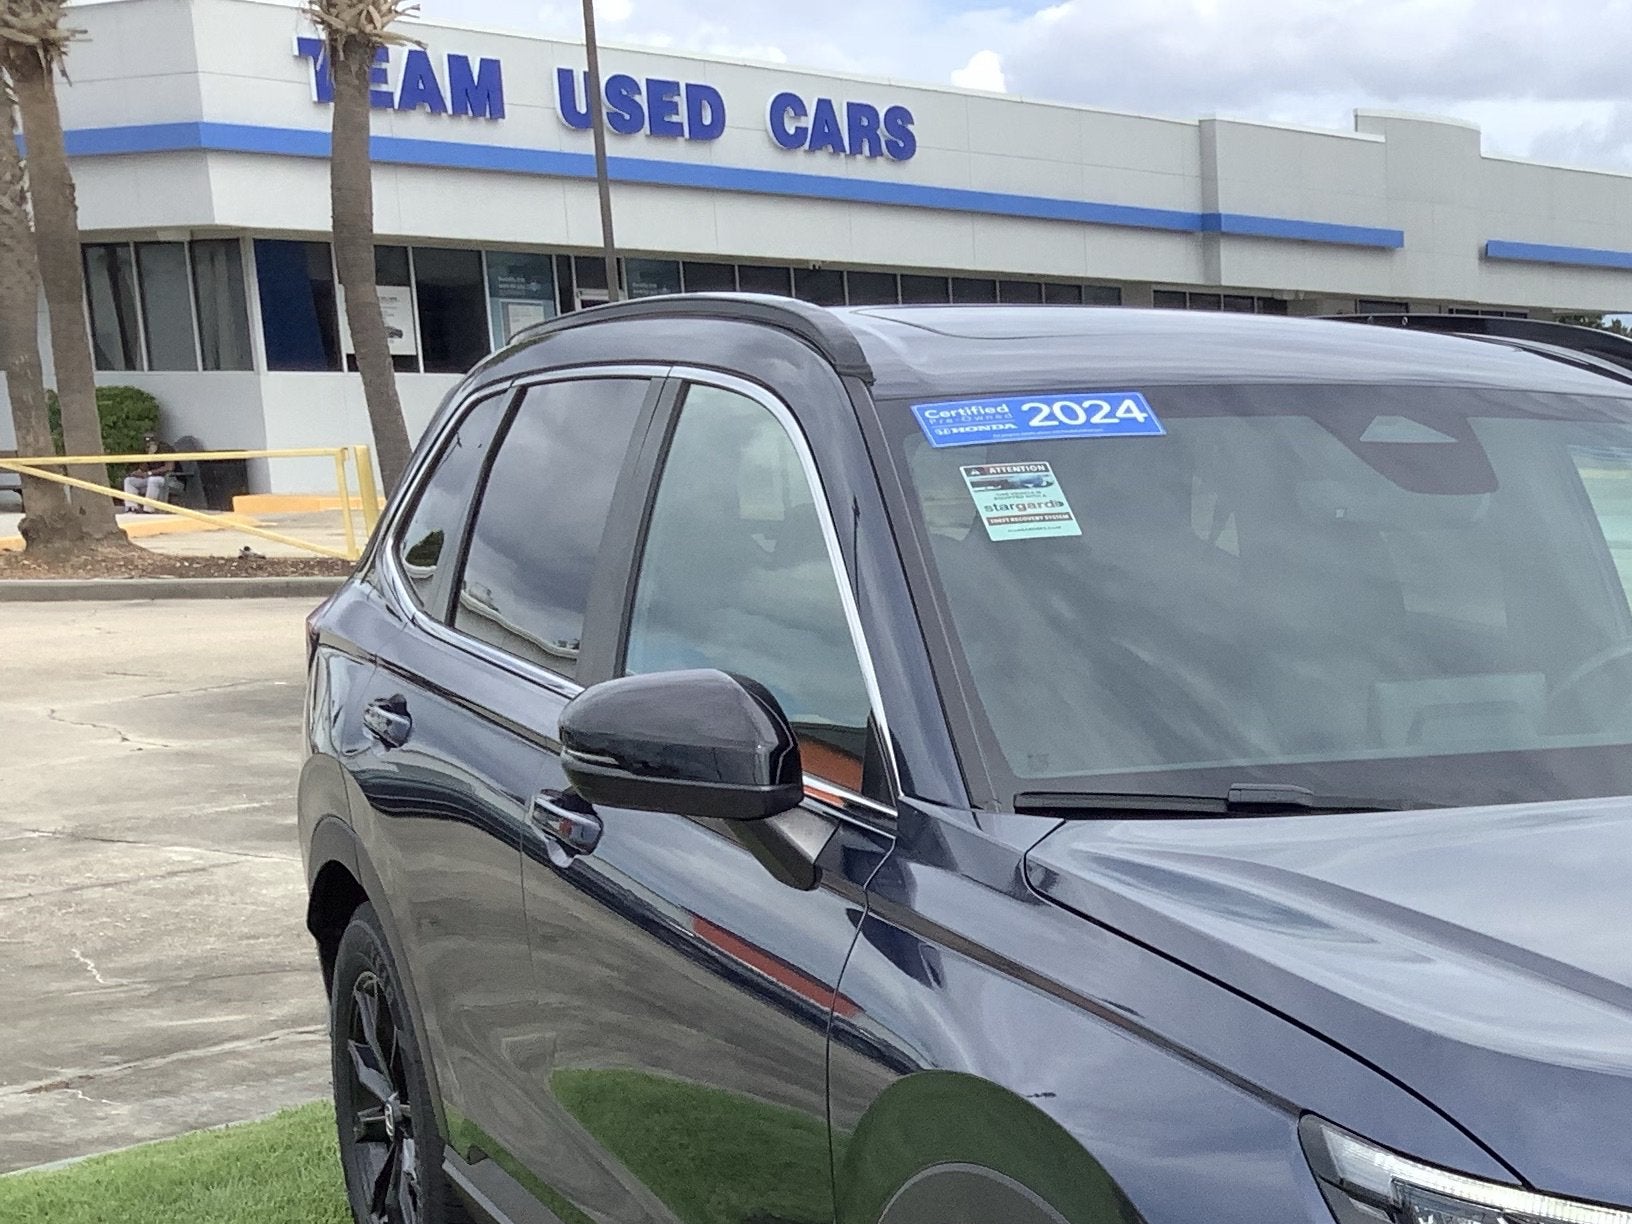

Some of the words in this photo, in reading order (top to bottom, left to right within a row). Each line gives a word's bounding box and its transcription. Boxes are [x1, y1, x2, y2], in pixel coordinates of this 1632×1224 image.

[296, 37, 505, 119] TEAM
[556, 66, 726, 142] USED
[765, 91, 918, 161] CARS
[924, 403, 1009, 419] Certified
[1021, 399, 1148, 427] 2024
[989, 465, 1045, 474] ATTENTION
